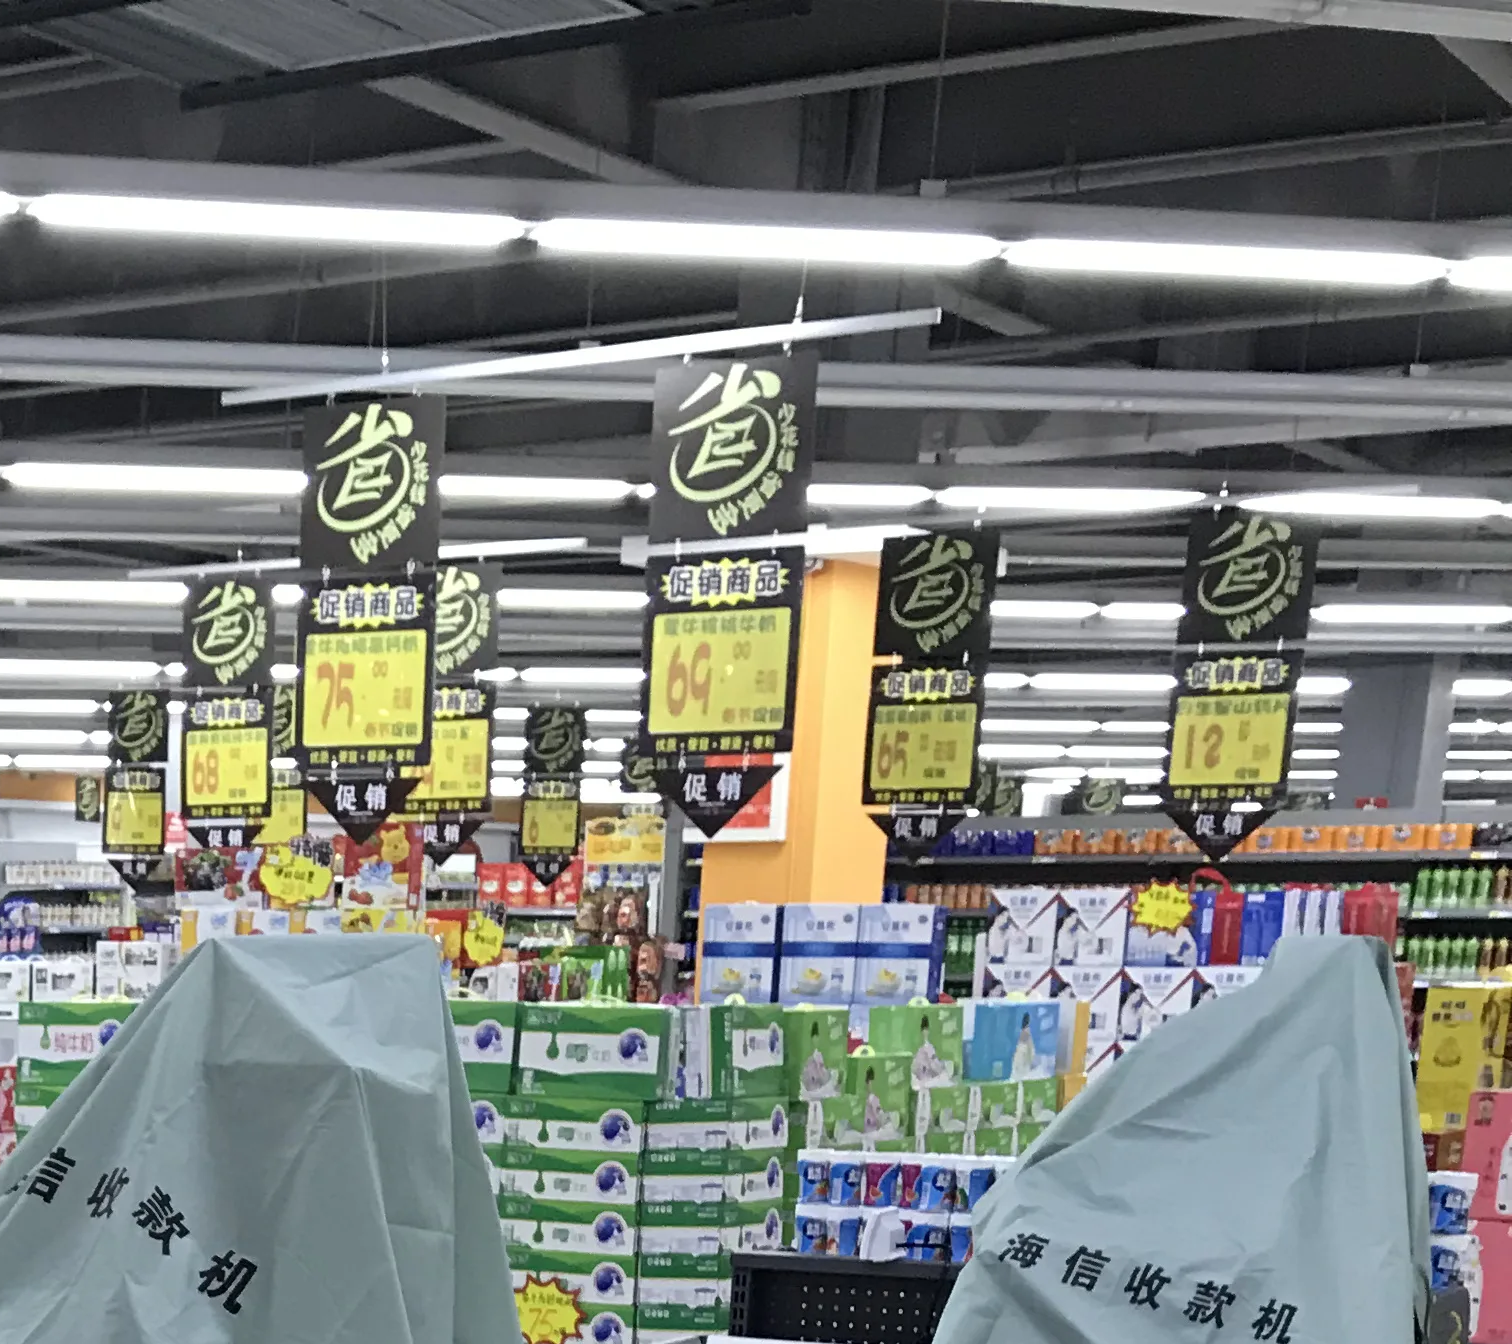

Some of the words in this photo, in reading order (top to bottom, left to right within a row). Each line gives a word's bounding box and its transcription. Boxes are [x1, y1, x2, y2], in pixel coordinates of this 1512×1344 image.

[668, 363, 781, 502] 省
[316, 403, 413, 532] 省
[670, 561, 782, 602] 促销商品
[319, 586, 419, 623] 促销商品
[666, 642, 714, 717] 69
[887, 669, 972, 697] 促销商品
[1191, 658, 1285, 689] 促销商品
[192, 699, 263, 725] 促销商品
[317, 661, 356, 731] 75
[192, 749, 219, 795] 68
[683, 771, 742, 803] 促销
[335, 783, 388, 811] 促销
[208, 828, 244, 848] 促销
[894, 817, 937, 838] 促销
[1195, 814, 1244, 836] 促销
